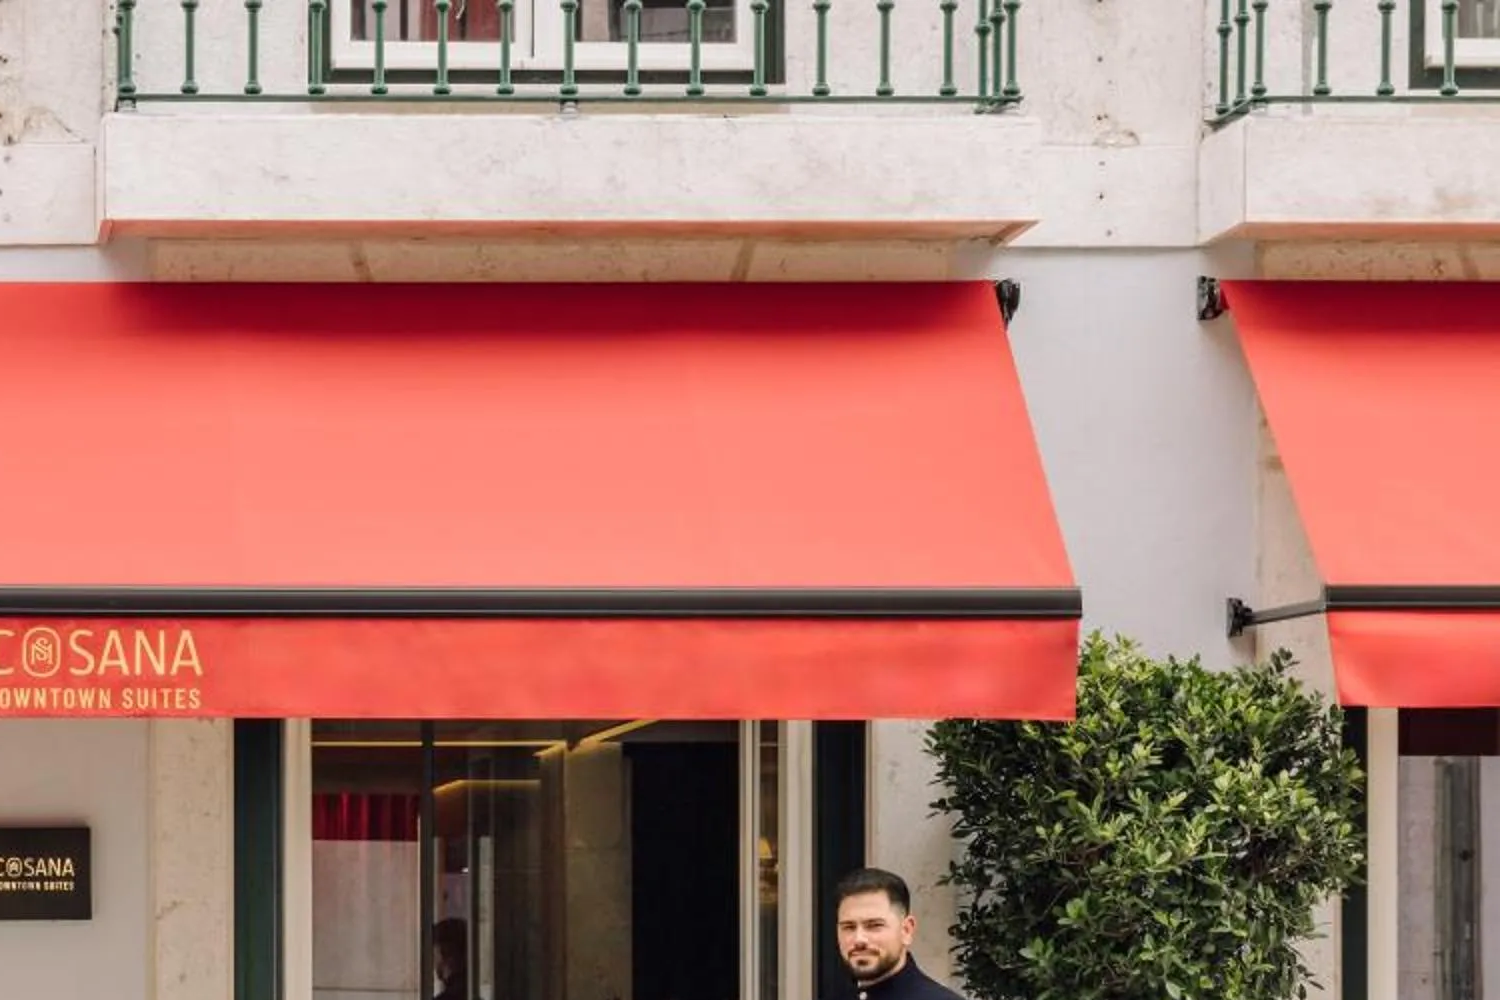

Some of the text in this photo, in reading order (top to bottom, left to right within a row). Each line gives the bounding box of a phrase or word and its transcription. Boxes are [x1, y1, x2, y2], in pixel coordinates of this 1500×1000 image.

[68, 629, 203, 676] SANA
[121, 687, 201, 710] SUITES
[24, 857, 75, 877] SANA
